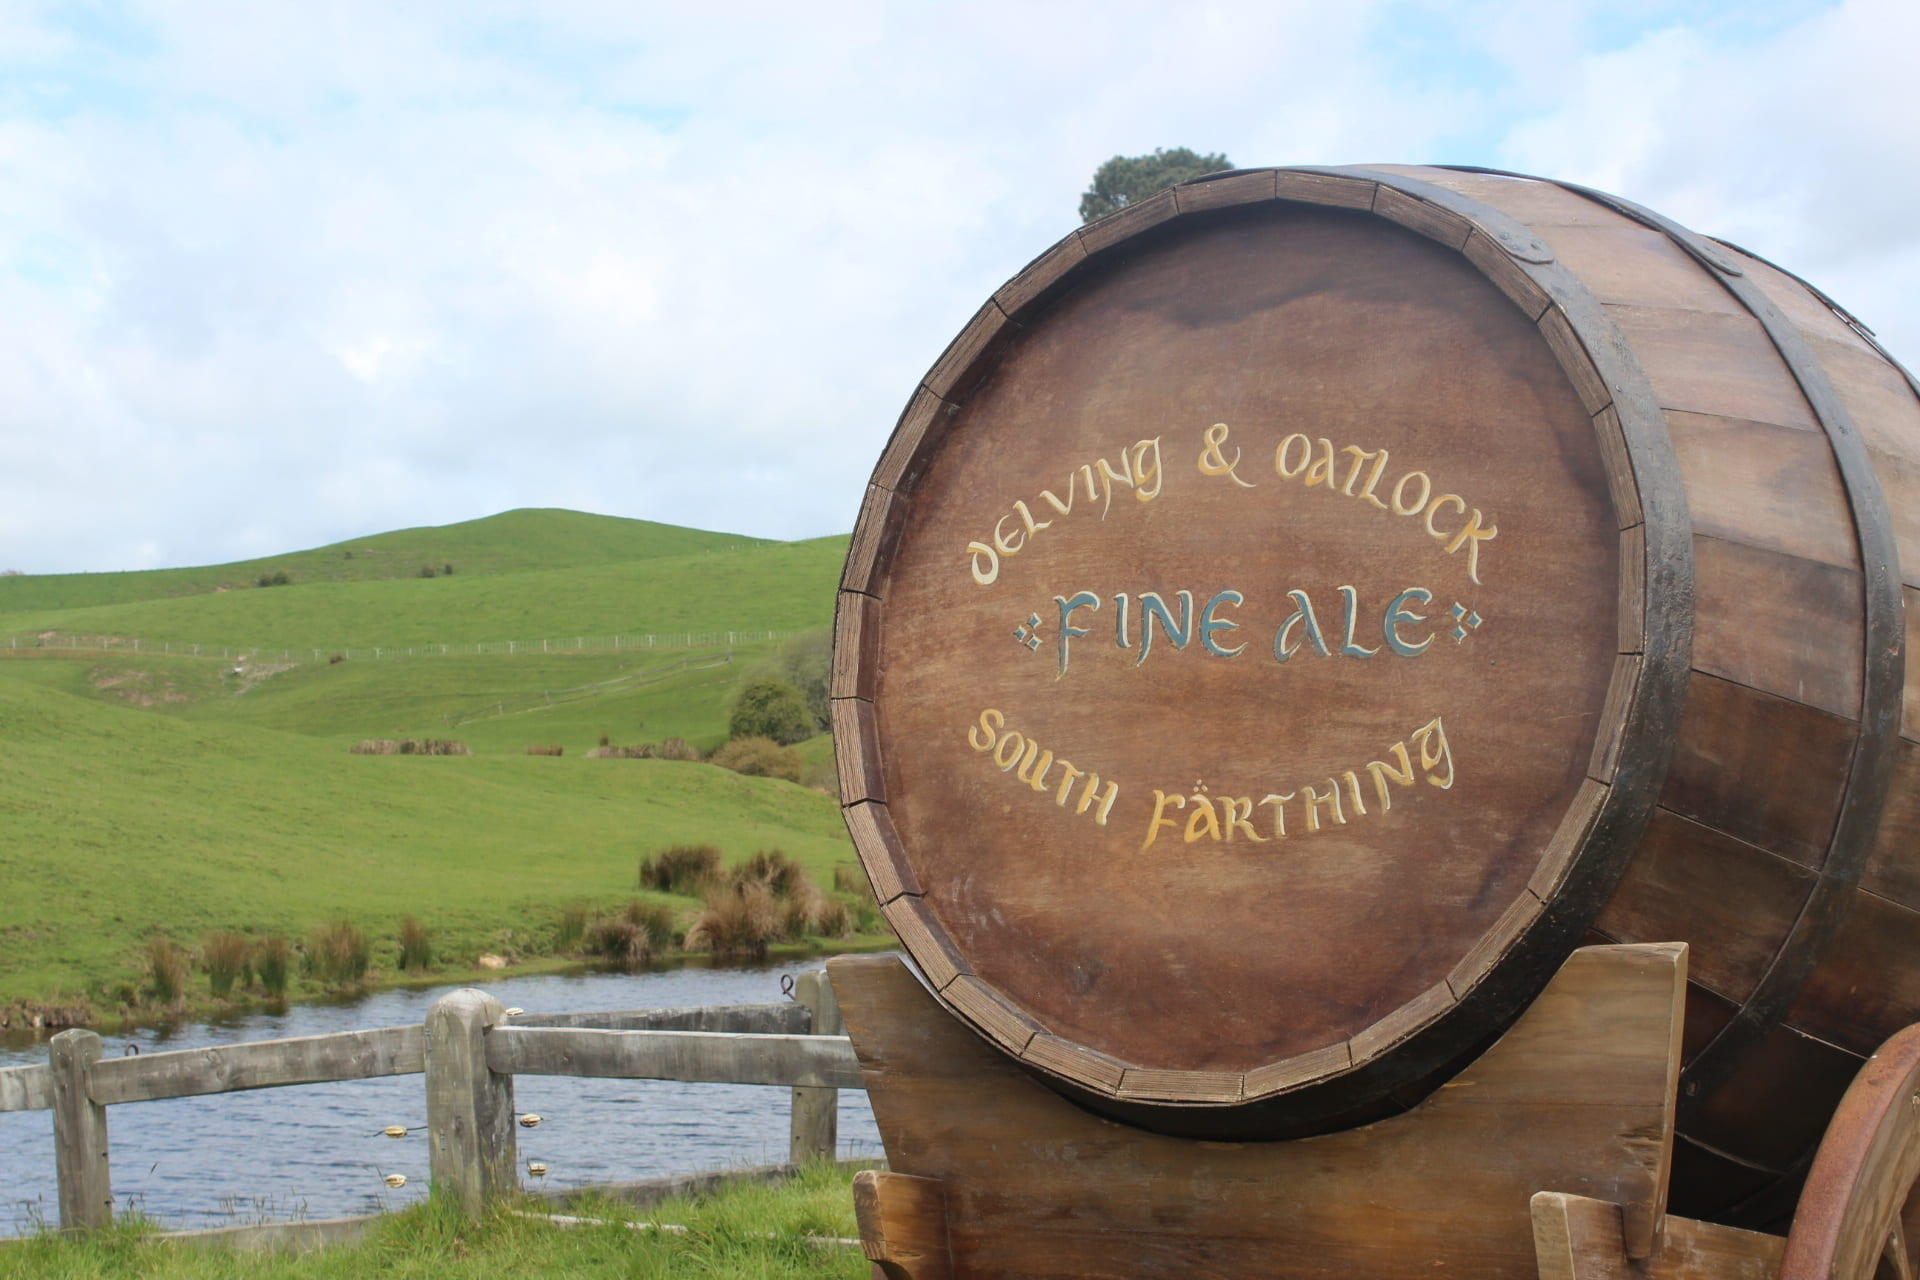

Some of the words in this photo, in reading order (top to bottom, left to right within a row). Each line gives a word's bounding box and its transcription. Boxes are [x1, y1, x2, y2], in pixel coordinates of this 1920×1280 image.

[1197, 422, 1257, 488] &
[1052, 589, 1249, 680] FINE
[1273, 585, 1436, 663] ALE
[968, 708, 1119, 826] SOUTH
